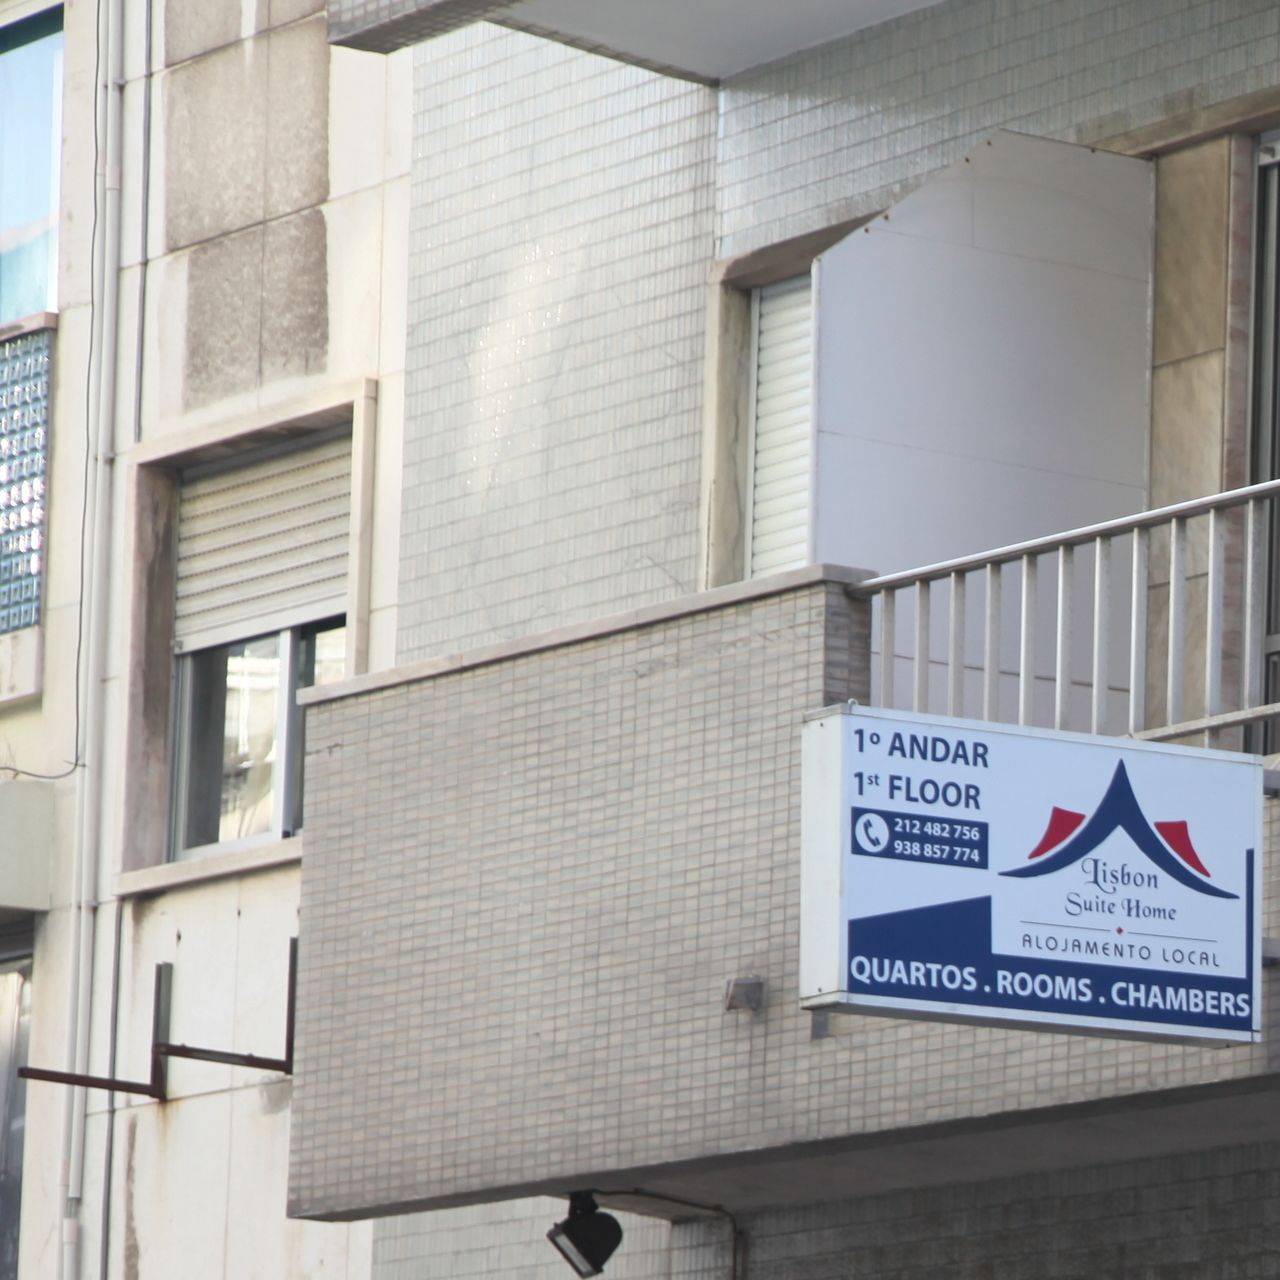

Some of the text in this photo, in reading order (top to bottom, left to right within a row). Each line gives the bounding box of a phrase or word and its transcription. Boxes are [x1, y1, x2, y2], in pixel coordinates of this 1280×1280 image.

[888, 732, 989, 769] ANDAR
[854, 771, 981, 810] 1st FLOOR
[894, 818, 980, 841] 212 482 756
[894, 840, 980, 863] 938 857 774
[1081, 857, 1158, 894] Lisbon
[1065, 892, 1177, 921] Suite Home
[1022, 933, 1220, 968] ALOJAMENTO LOCAL
[850, 955, 977, 991] QUARTOS
[997, 970, 1093, 1002] ROOMS
[1111, 981, 1250, 1018] CHAMBERS
